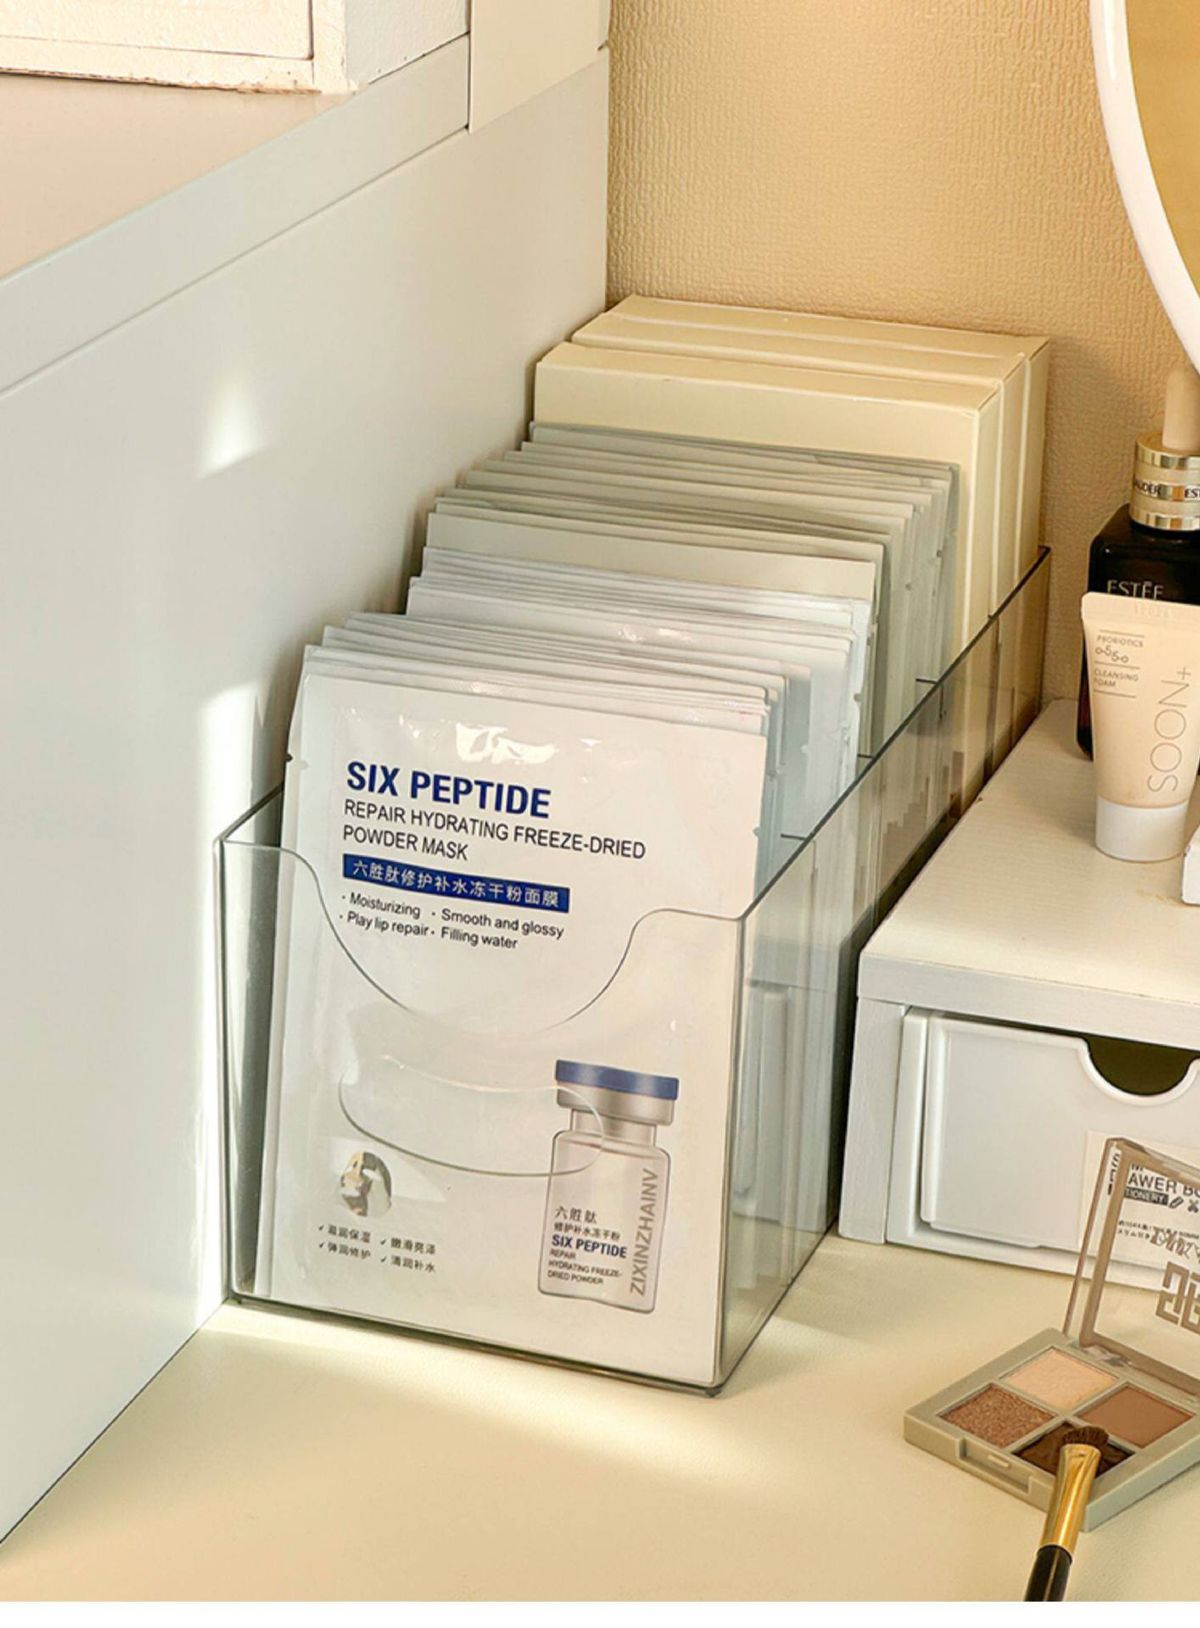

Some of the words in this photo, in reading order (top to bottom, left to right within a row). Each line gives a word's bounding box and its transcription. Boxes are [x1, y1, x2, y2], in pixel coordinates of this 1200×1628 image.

[1096, 635, 1144, 648] PROBIOTICS
[1093, 678, 1116, 687] FOAM
[1094, 668, 1139, 682] CLEANSING
[346, 761, 400, 797] SIX
[410, 770, 551, 819] PEPTIDE
[344, 798, 406, 824] REPAIR
[410, 809, 509, 841] HYDRATING
[513, 825, 646, 860] FREEZE-DRIED
[343, 825, 418, 853] POWDER
[421, 837, 469, 861] MASK
[352, 860, 560, 908] 六胜肽修护补水冻干粉面膜
[350, 892, 421, 920] Moisturizing
[441, 908, 491, 928] Smooth
[494, 913, 519, 931] and
[521, 918, 565, 940] glossy
[347, 911, 373, 932] Play
[374, 915, 390, 935] lip
[391, 920, 429, 939] repair
[441, 926, 479, 947] Filling
[481, 931, 518, 949] water
[555, 1205, 597, 1225] 六胜肽
[630, 1168, 659, 1296] ZIXINZHAINV
[549, 1249, 576, 1260] REPAIR
[552, 1235, 573, 1249] SIX
[576, 1238, 627, 1259] PEPTIDE
[547, 1271, 570, 1281] DRIED
[571, 1273, 604, 1285] POWDER
[549, 1259, 590, 1274] HYDRATING
